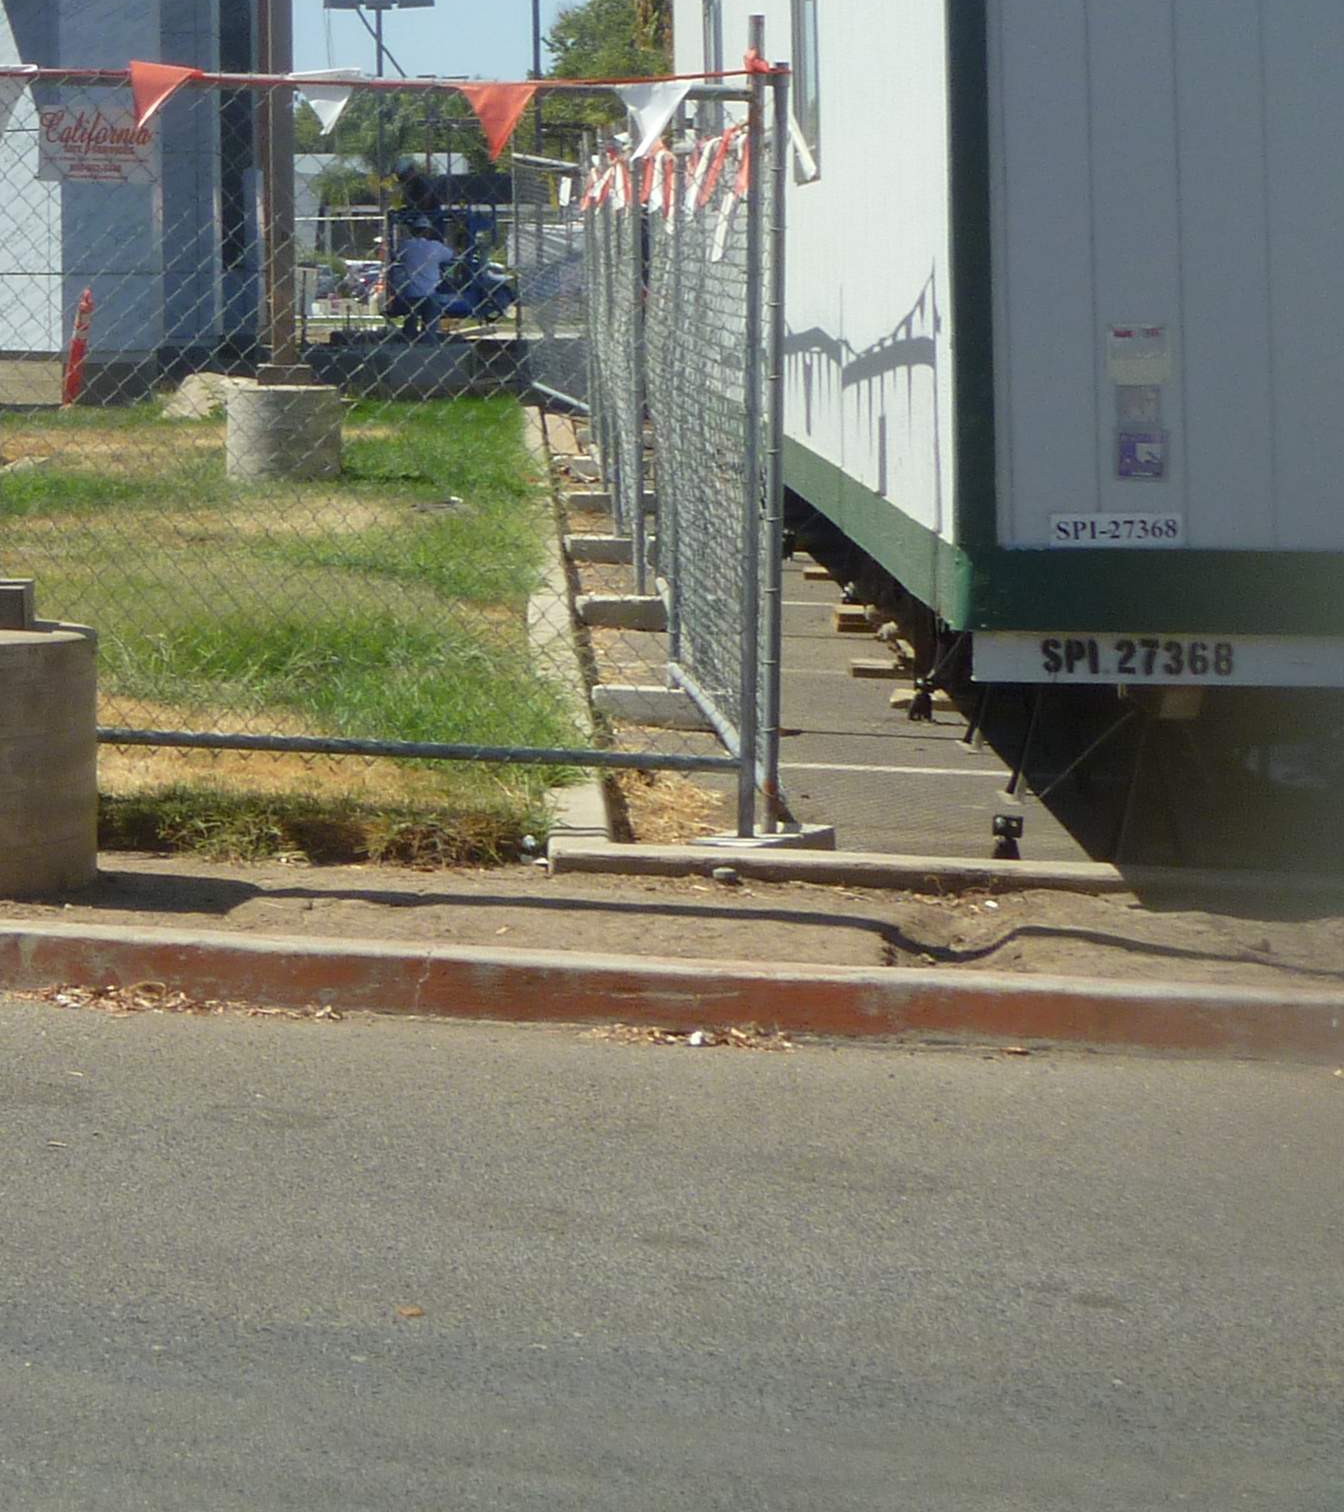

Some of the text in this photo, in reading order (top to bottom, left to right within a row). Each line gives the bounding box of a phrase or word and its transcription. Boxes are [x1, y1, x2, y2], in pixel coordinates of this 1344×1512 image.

[40, 110, 153, 156] California
[1055, 519, 1179, 541] SPI-27368
[1041, 638, 1234, 677] SPI 27368
